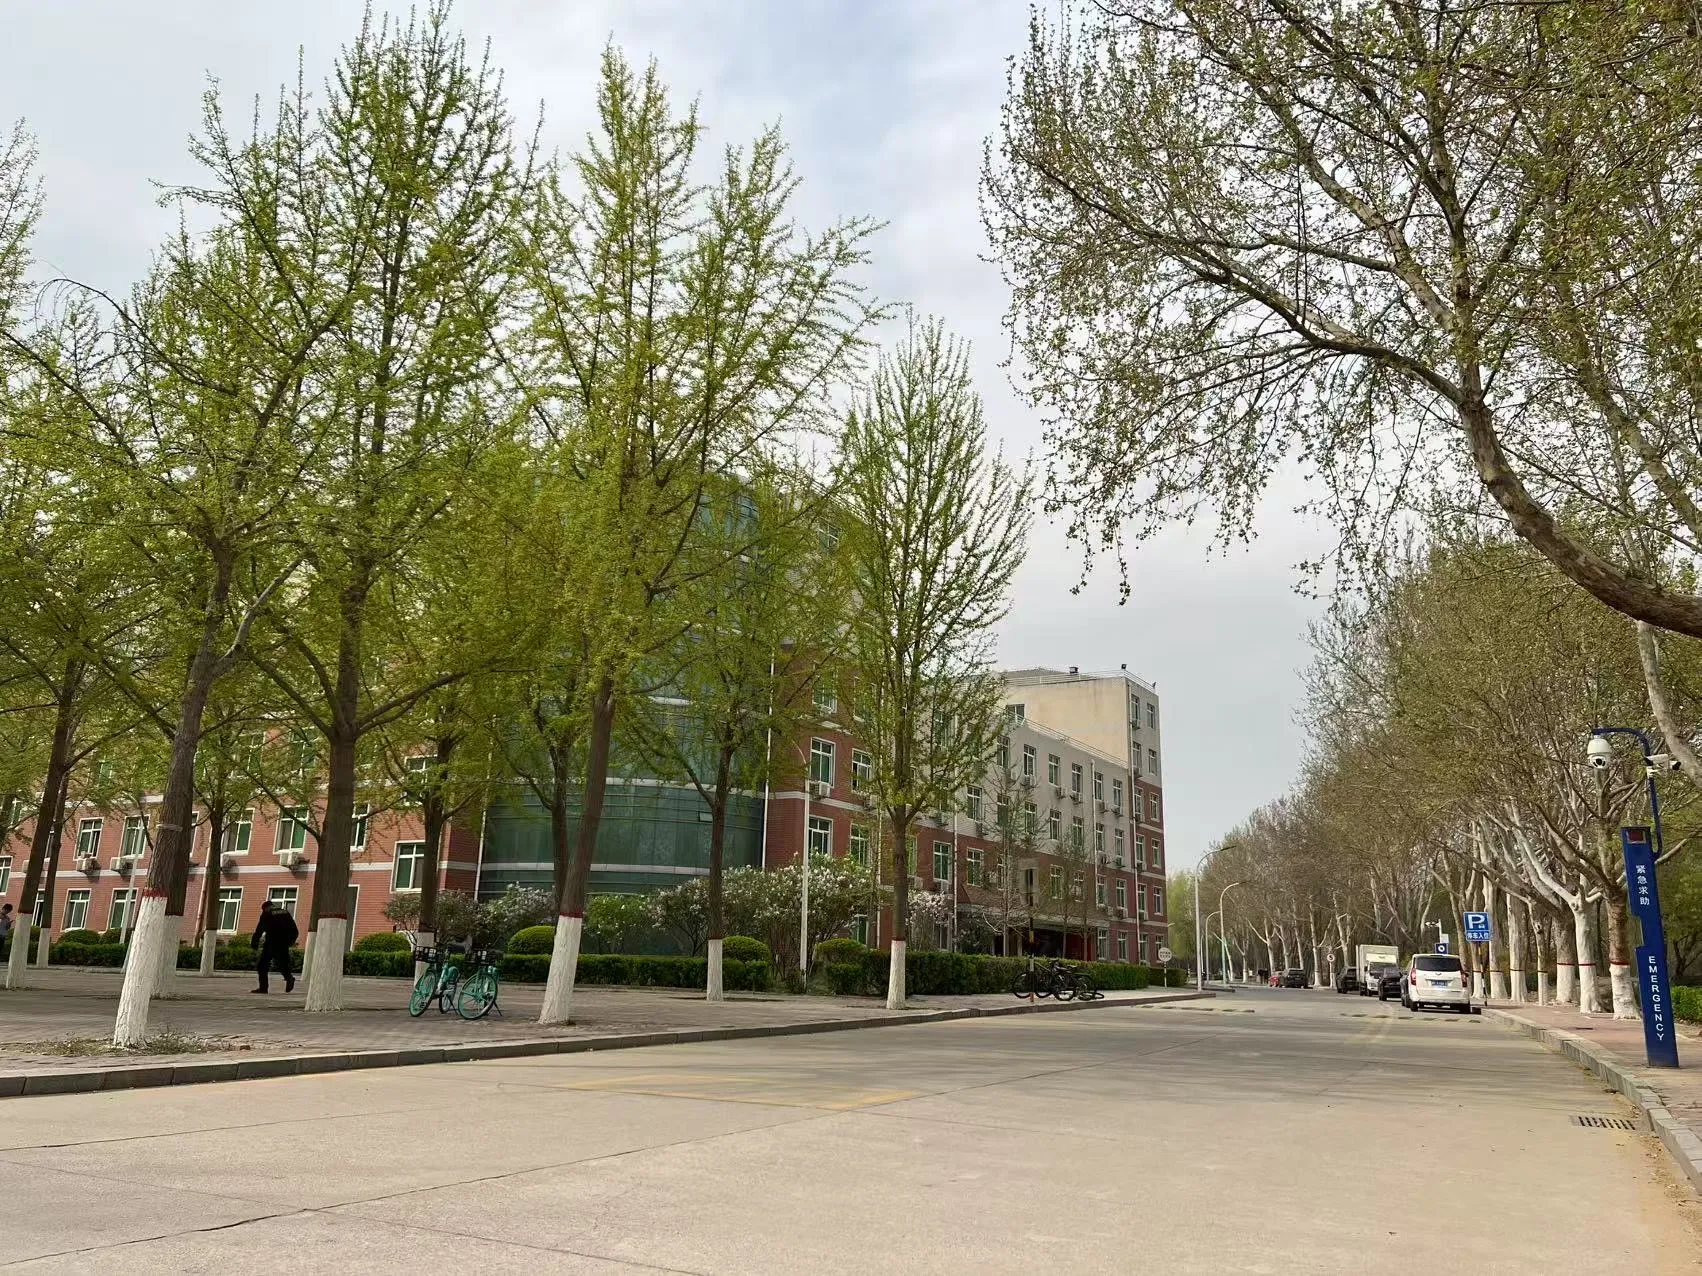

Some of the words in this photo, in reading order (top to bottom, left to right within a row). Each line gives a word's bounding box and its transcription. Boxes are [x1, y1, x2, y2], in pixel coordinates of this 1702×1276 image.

[1635, 864, 1650, 906] 紧急求助
[1467, 914, 1486, 929] P
[1648, 955, 1664, 1041] EMERGENCY
